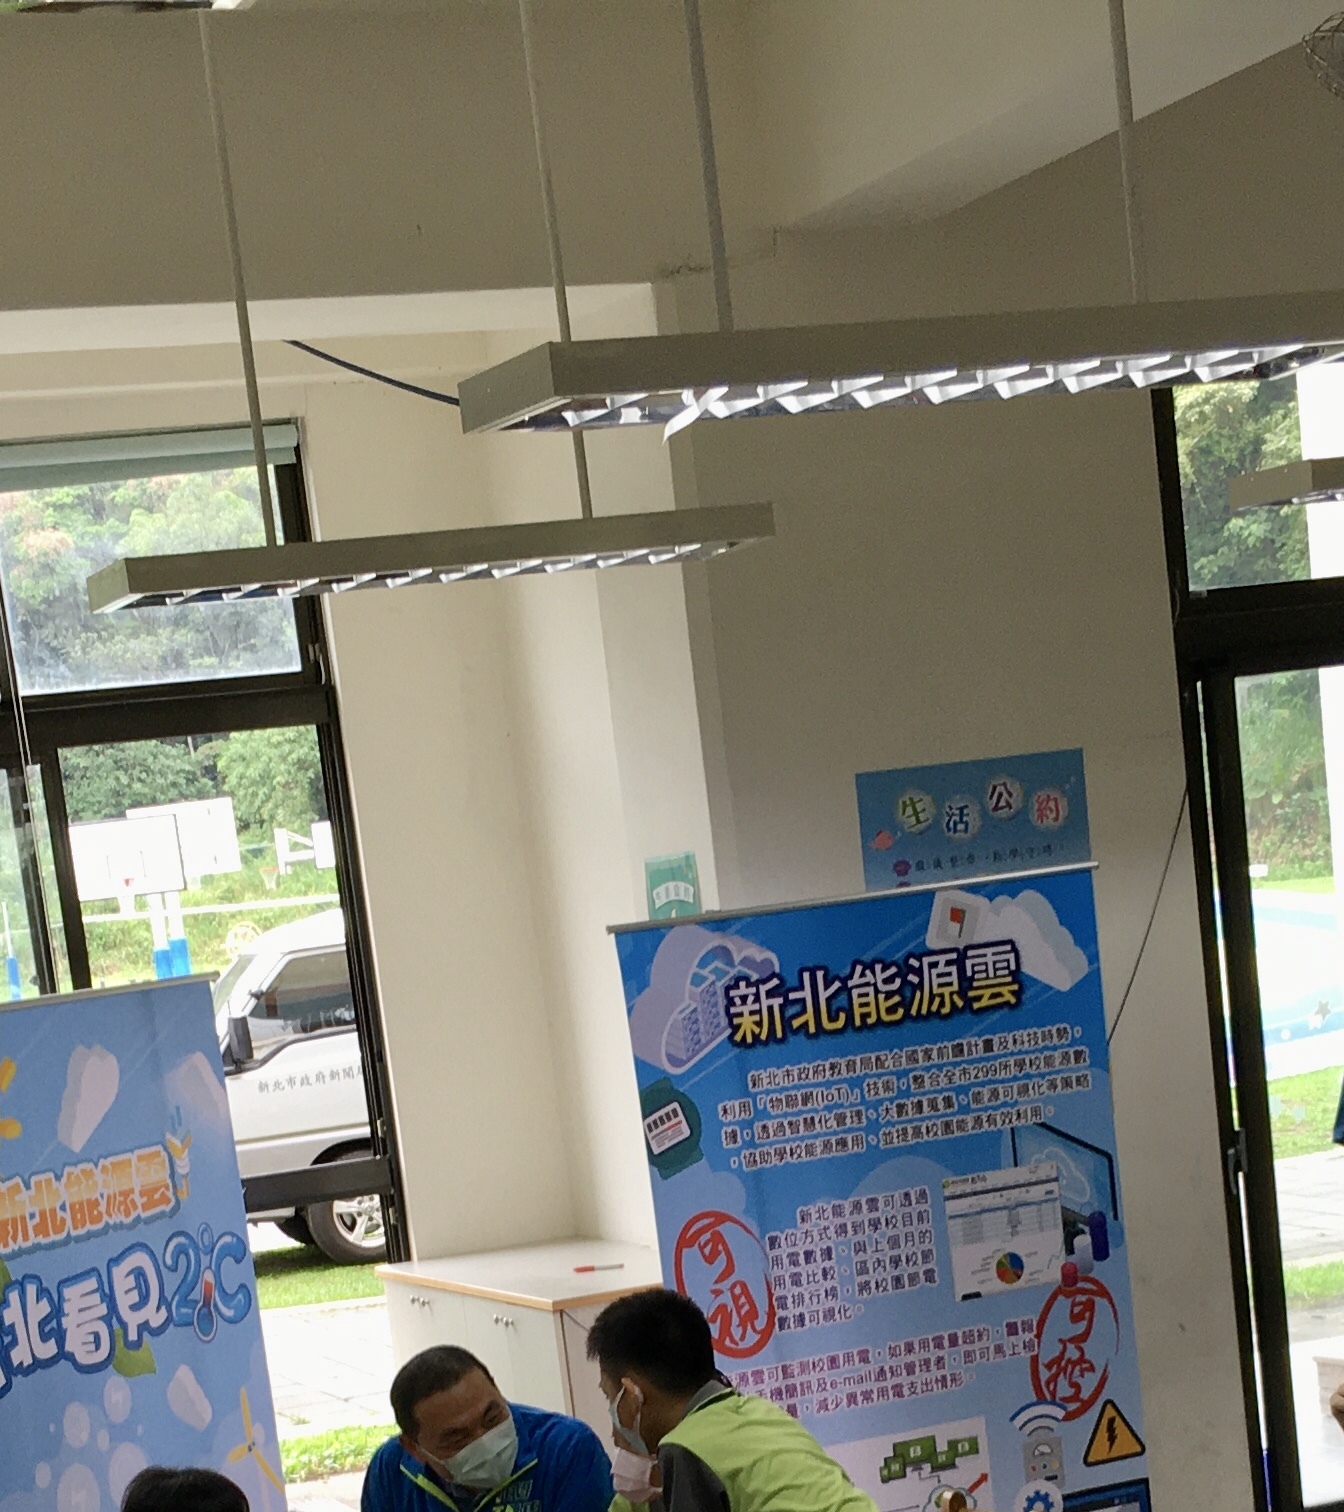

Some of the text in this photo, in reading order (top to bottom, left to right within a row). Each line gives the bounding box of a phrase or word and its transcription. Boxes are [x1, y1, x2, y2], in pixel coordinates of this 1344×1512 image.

[901, 781, 1061, 835] 生活公約
[729, 944, 1020, 1045] 新北能源雲
[799, 1188, 929, 1225] 新北能源雲可透過
[768, 1210, 930, 1251] 數位方式得到學校目前
[770, 1229, 933, 1271] 用電數據、與上個月的
[773, 1248, 935, 1291] 用電比較、區內學校節
[775, 1267, 937, 1311] 電排行榜，將校園節電
[777, 1303, 863, 1332] 數據可視化。
